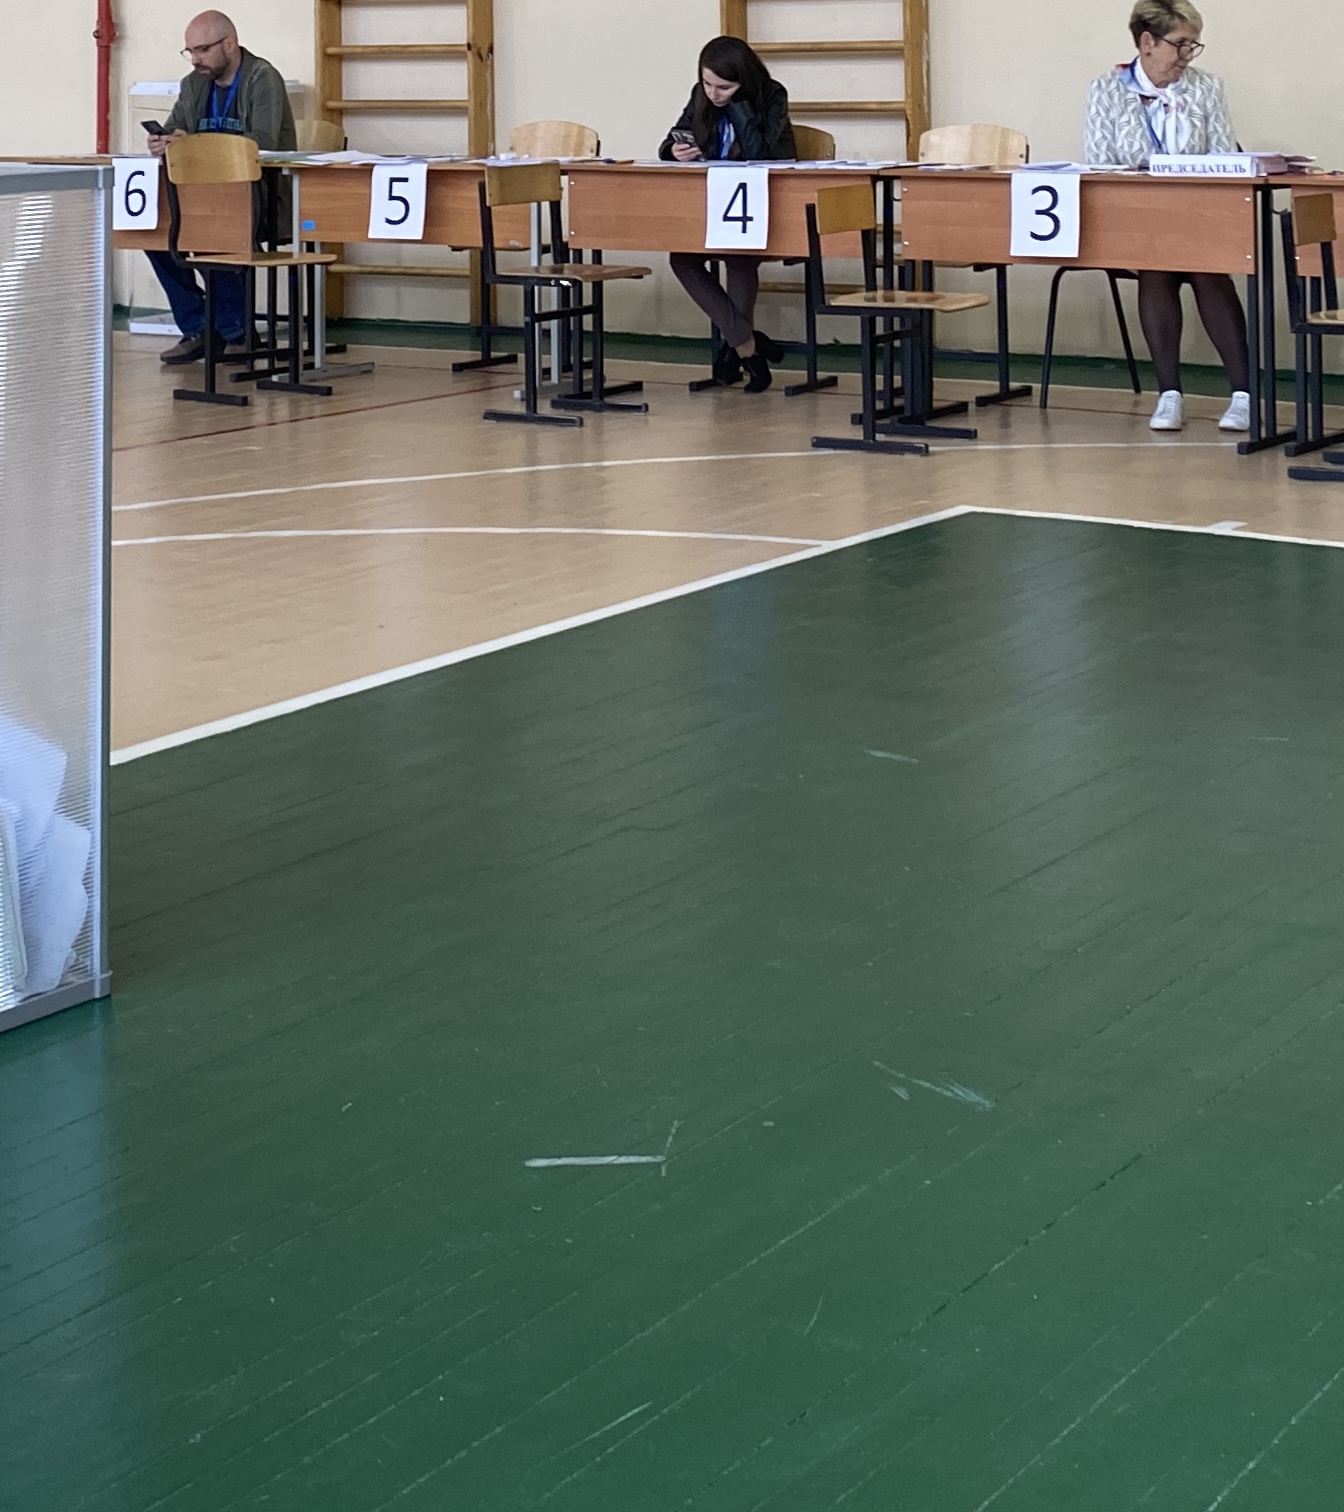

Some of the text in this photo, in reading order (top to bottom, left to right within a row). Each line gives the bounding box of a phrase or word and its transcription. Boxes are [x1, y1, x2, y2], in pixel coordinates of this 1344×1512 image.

[124, 170, 147, 217] 6
[1152, 164, 1247, 174] ПРЕДСЕДАТЕЛЬ
[384, 176, 410, 226] 5
[722, 182, 754, 234] 4
[1029, 184, 1061, 242] 3
